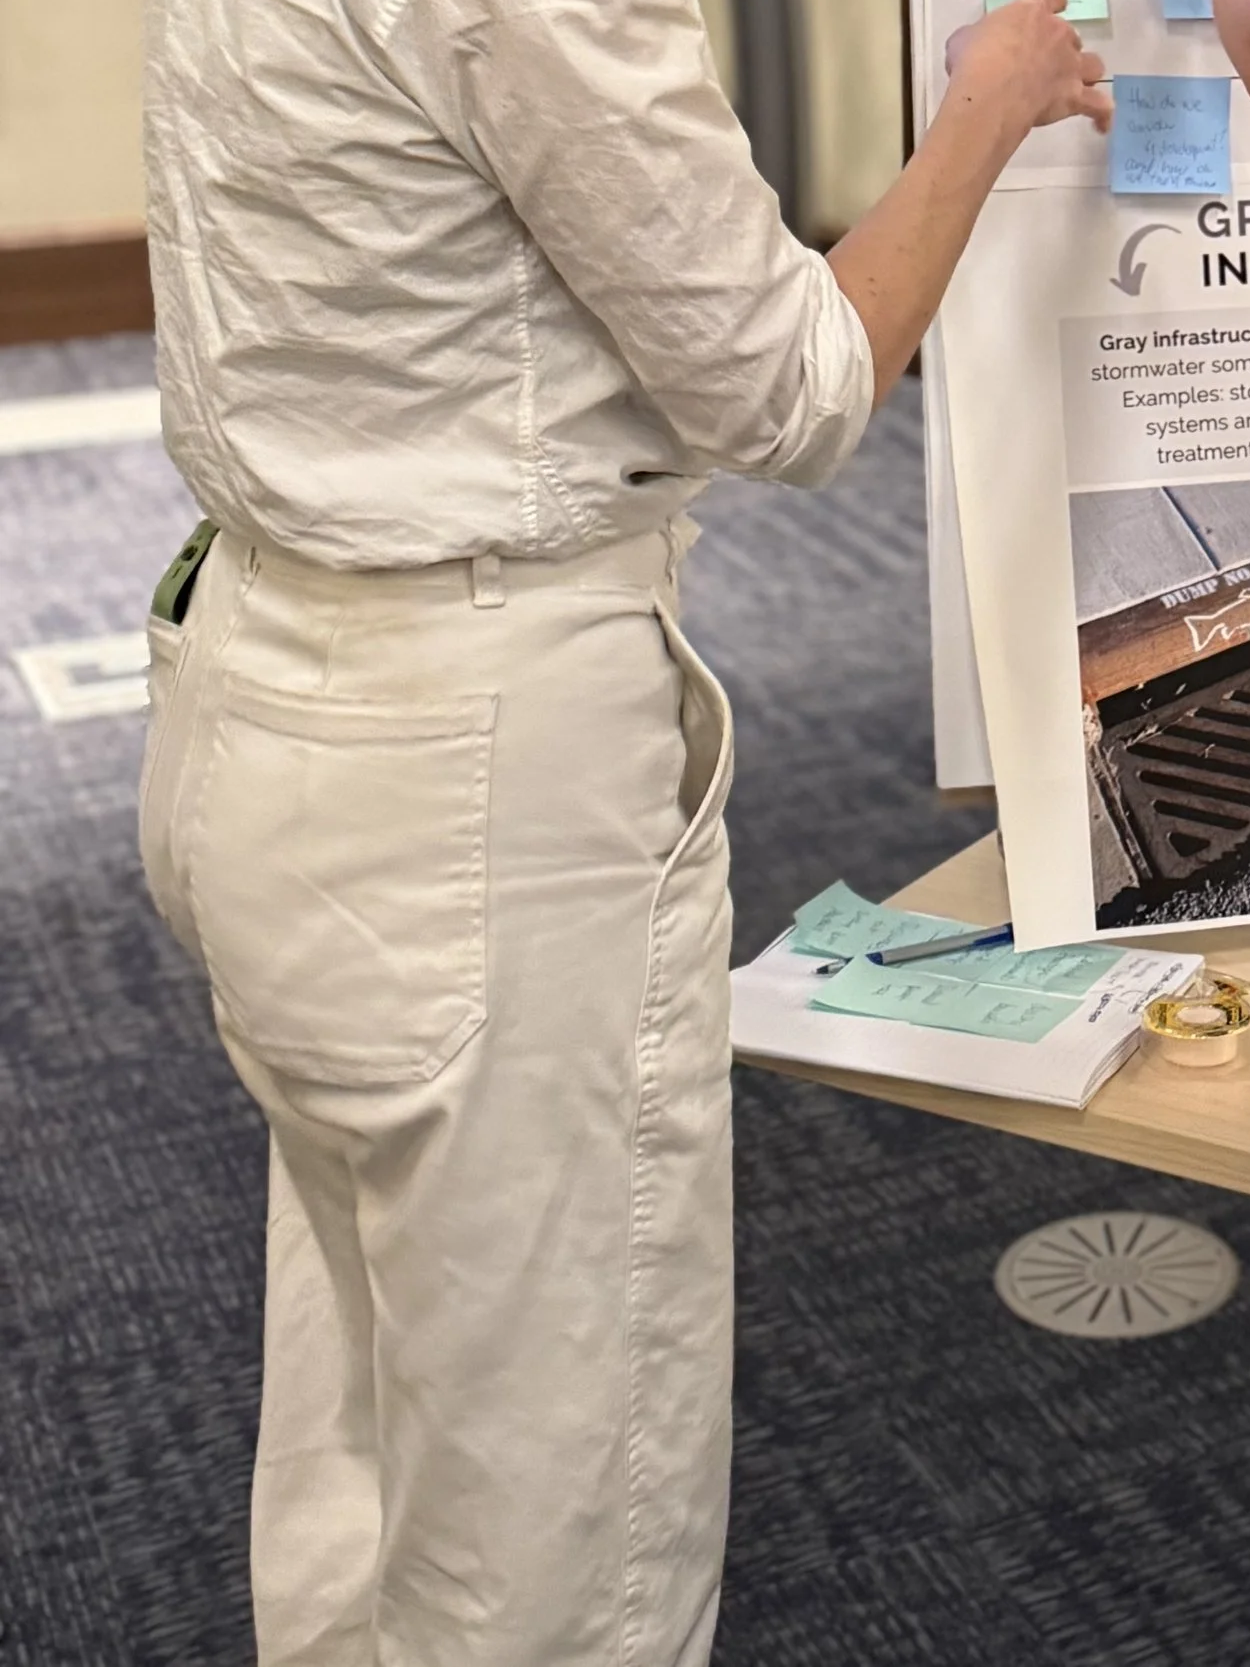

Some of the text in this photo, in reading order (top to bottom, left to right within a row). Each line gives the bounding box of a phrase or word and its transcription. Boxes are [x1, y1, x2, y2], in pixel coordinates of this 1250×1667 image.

[1100, 333, 1147, 354] Gray
[1091, 358, 1206, 382] stormwater
[1122, 386, 1225, 409] Examples:
[1145, 415, 1229, 440] systems
[1160, 577, 1219, 609] DUMP
